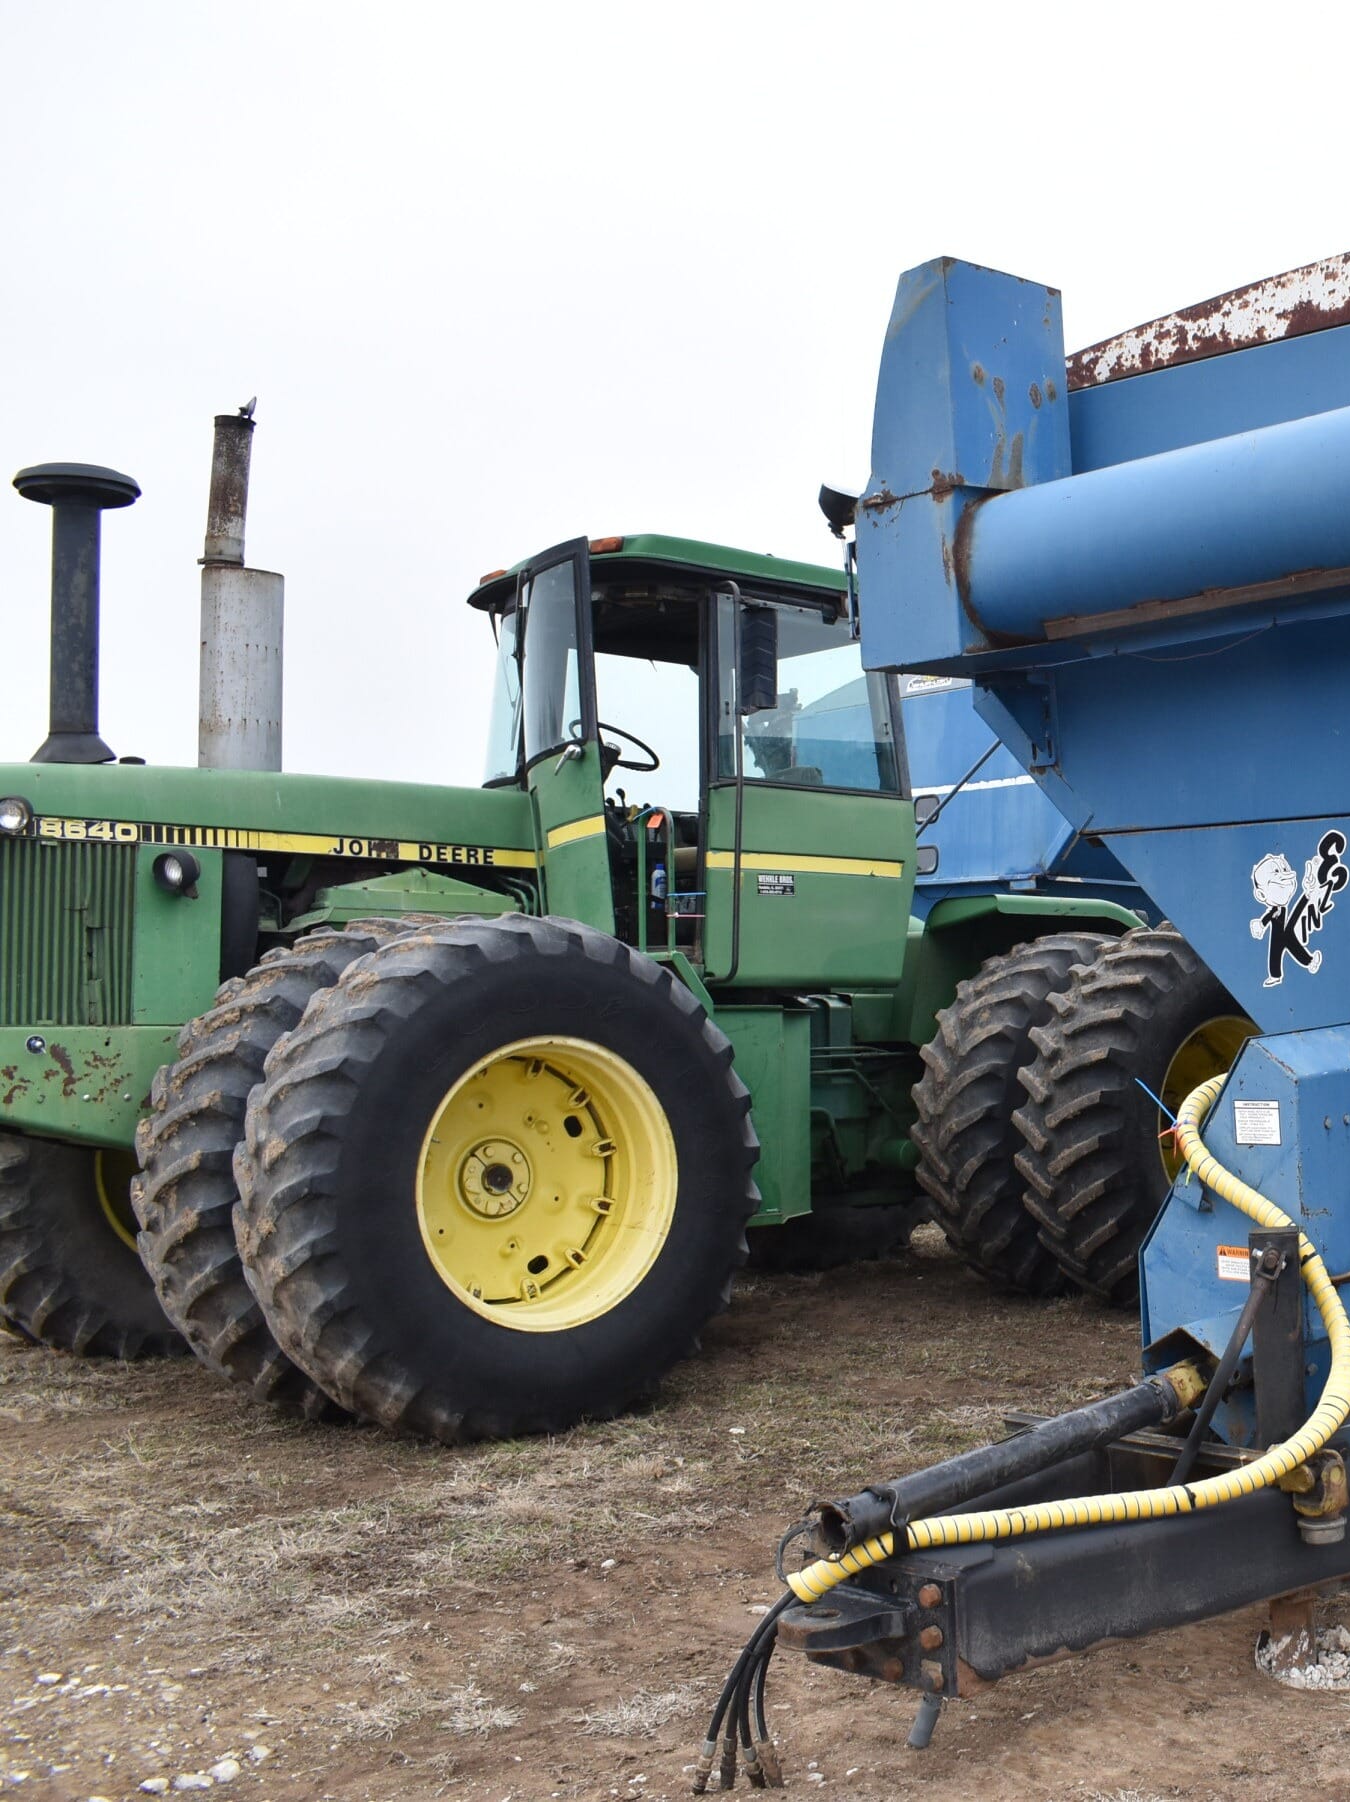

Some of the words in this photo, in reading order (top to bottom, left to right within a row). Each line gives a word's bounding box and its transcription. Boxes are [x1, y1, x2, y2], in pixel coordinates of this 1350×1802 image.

[40, 818, 138, 841] 8640
[418, 845, 494, 865] DEERE
[1262, 831, 1348, 978] KINZE
[1227, 1248, 1249, 1257] WARNIN
